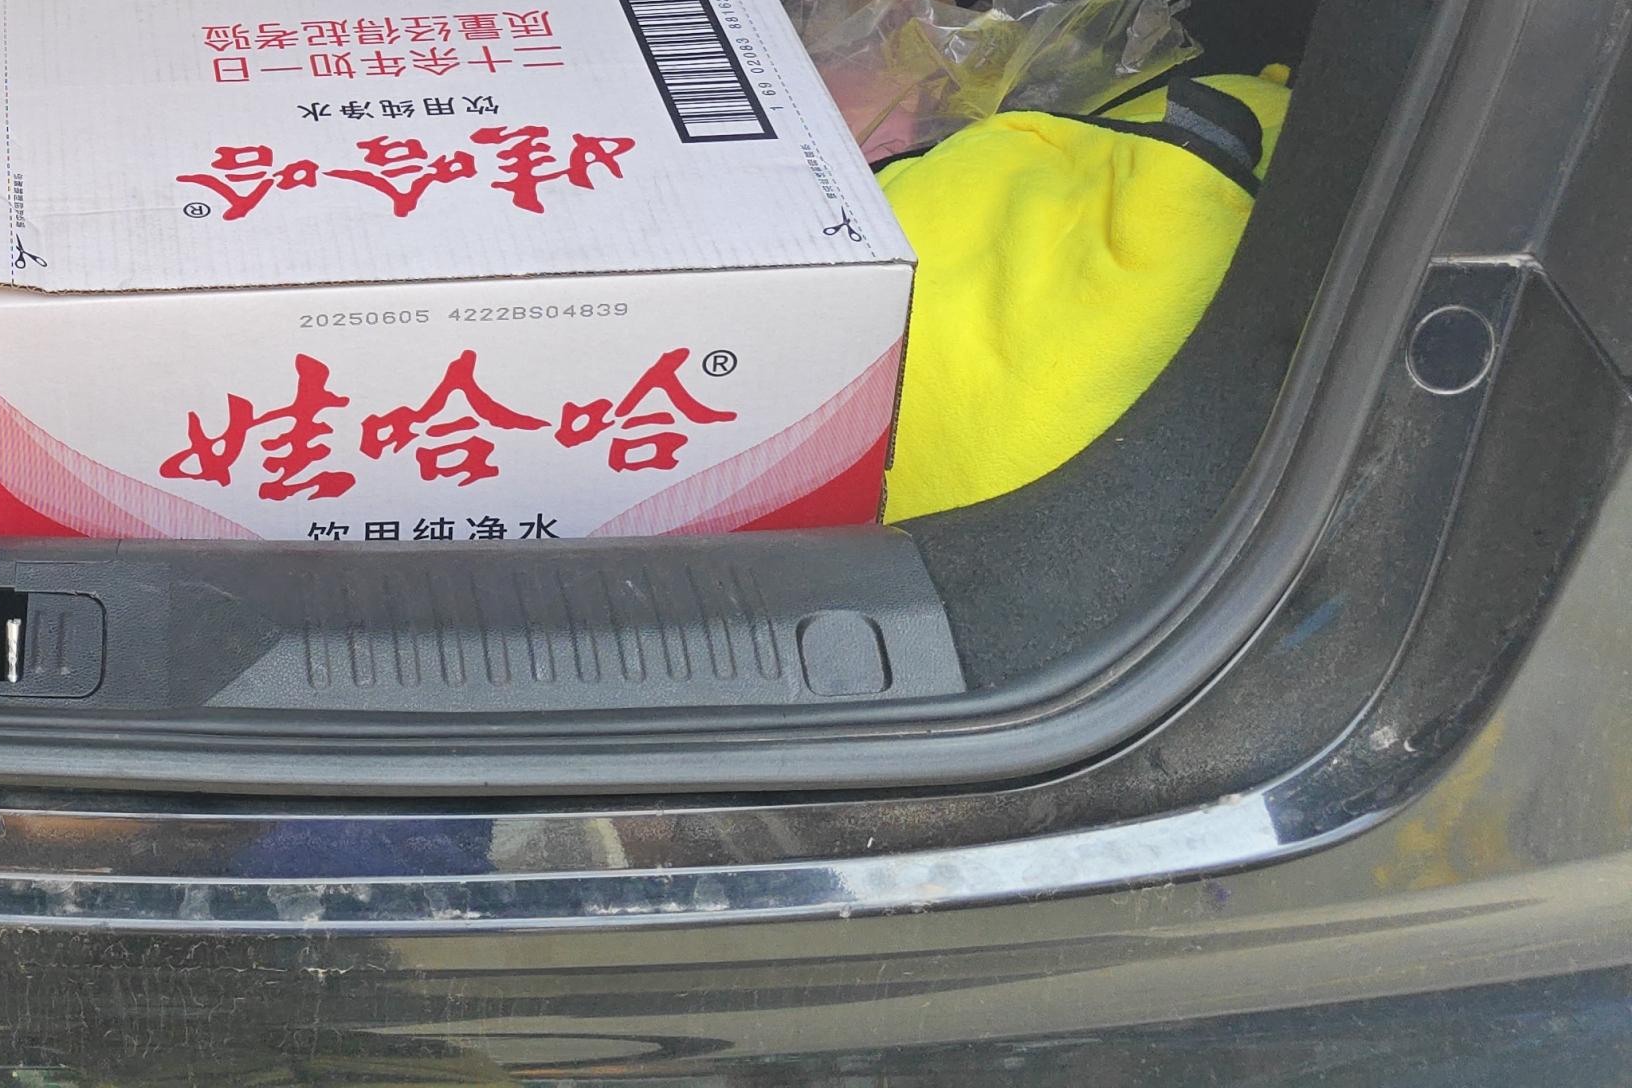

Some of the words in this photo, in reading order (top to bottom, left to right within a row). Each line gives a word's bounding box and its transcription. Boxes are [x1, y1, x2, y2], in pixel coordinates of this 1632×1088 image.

[201, 10, 554, 52] 质量经得起考验
[212, 45, 565, 83] 二十余年如一日
[736, 37, 764, 74] 02083
[758, 82, 777, 96] 69
[296, 95, 500, 122] 饮用纯净水
[175, 125, 636, 221] 娃哈哈
[299, 309, 430, 329] 20250605
[448, 302, 629, 323] 4222BS04839
[158, 347, 738, 502] 娃哈哈
